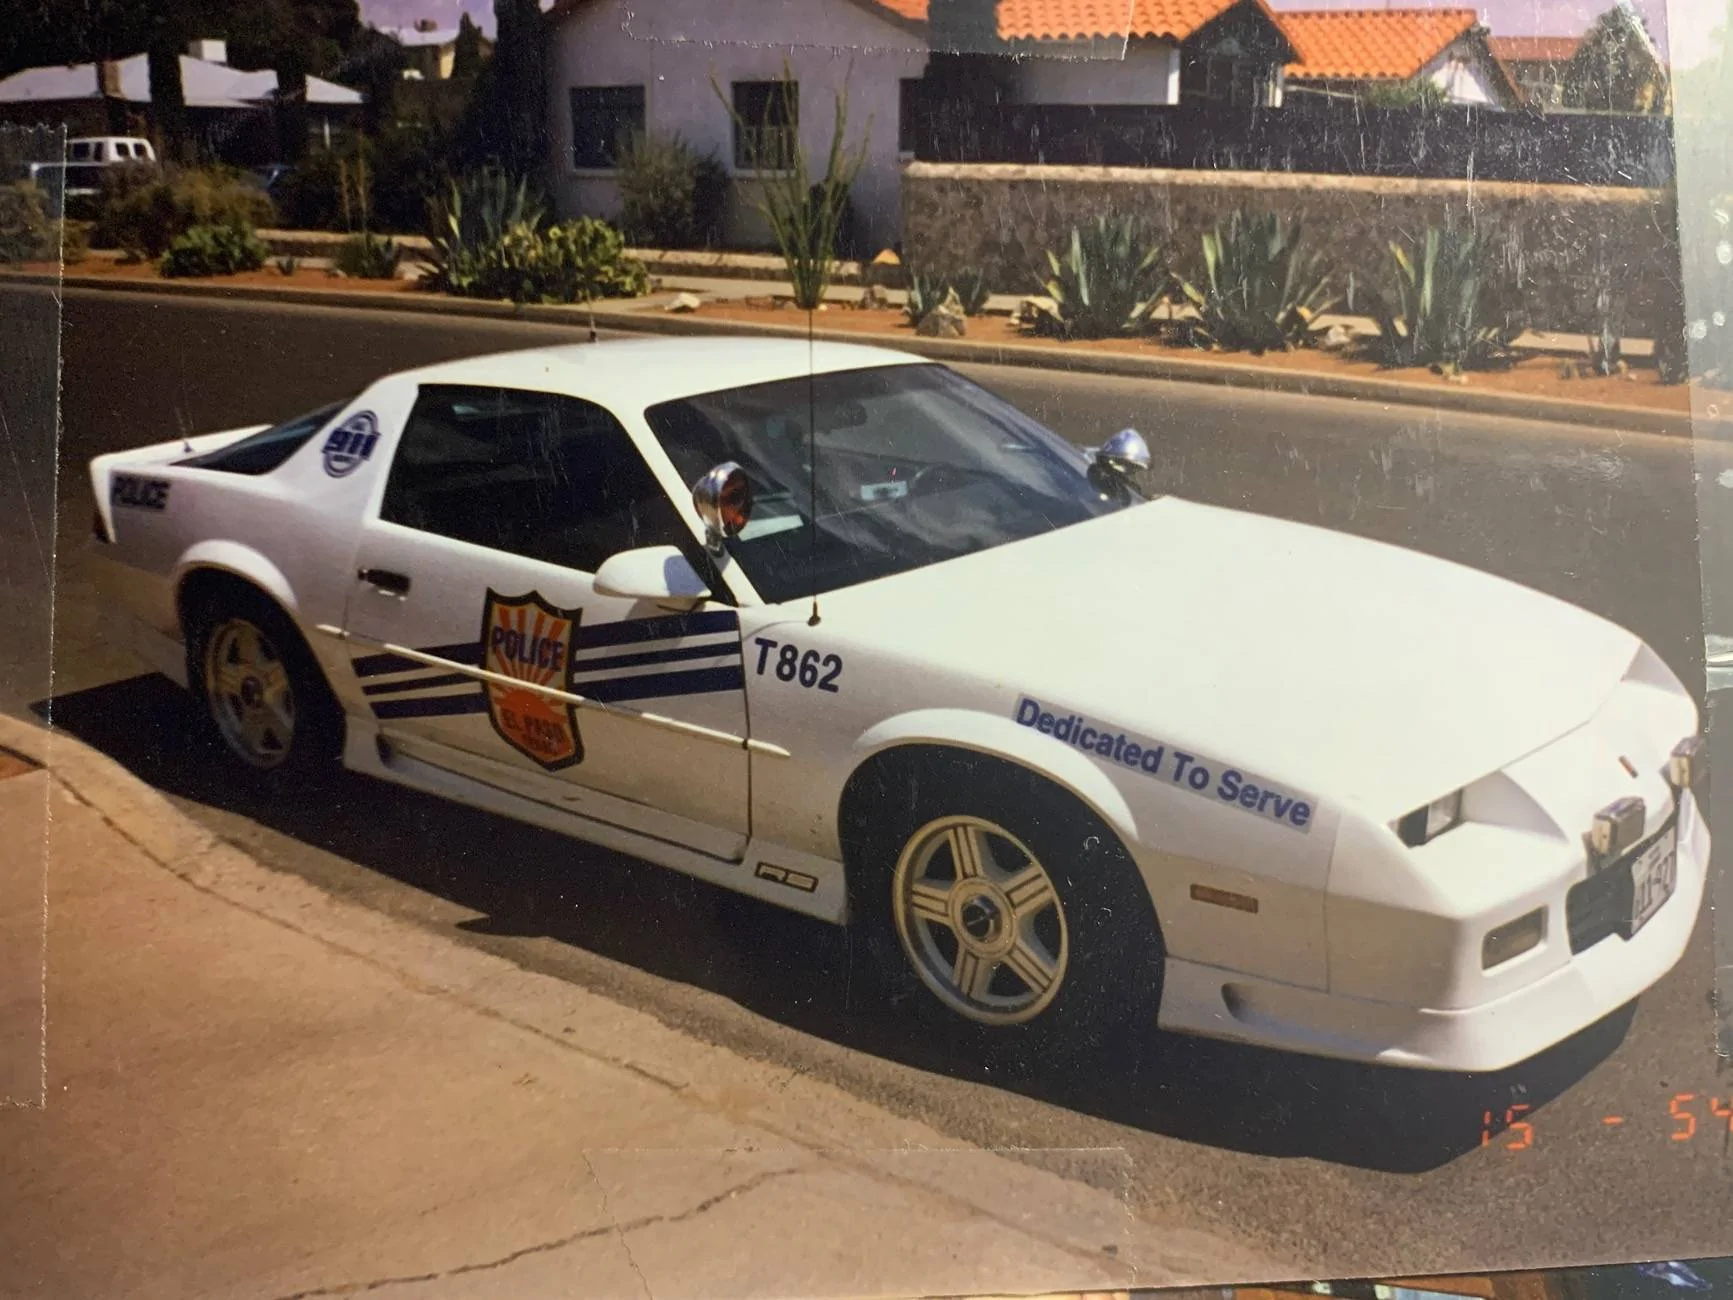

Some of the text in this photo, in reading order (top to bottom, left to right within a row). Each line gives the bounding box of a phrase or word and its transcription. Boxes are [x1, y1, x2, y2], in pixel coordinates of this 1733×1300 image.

[492, 624, 564, 671] POLICE
[755, 637, 843, 693] T862
[1016, 698, 1311, 826] Dedicated To Serve
